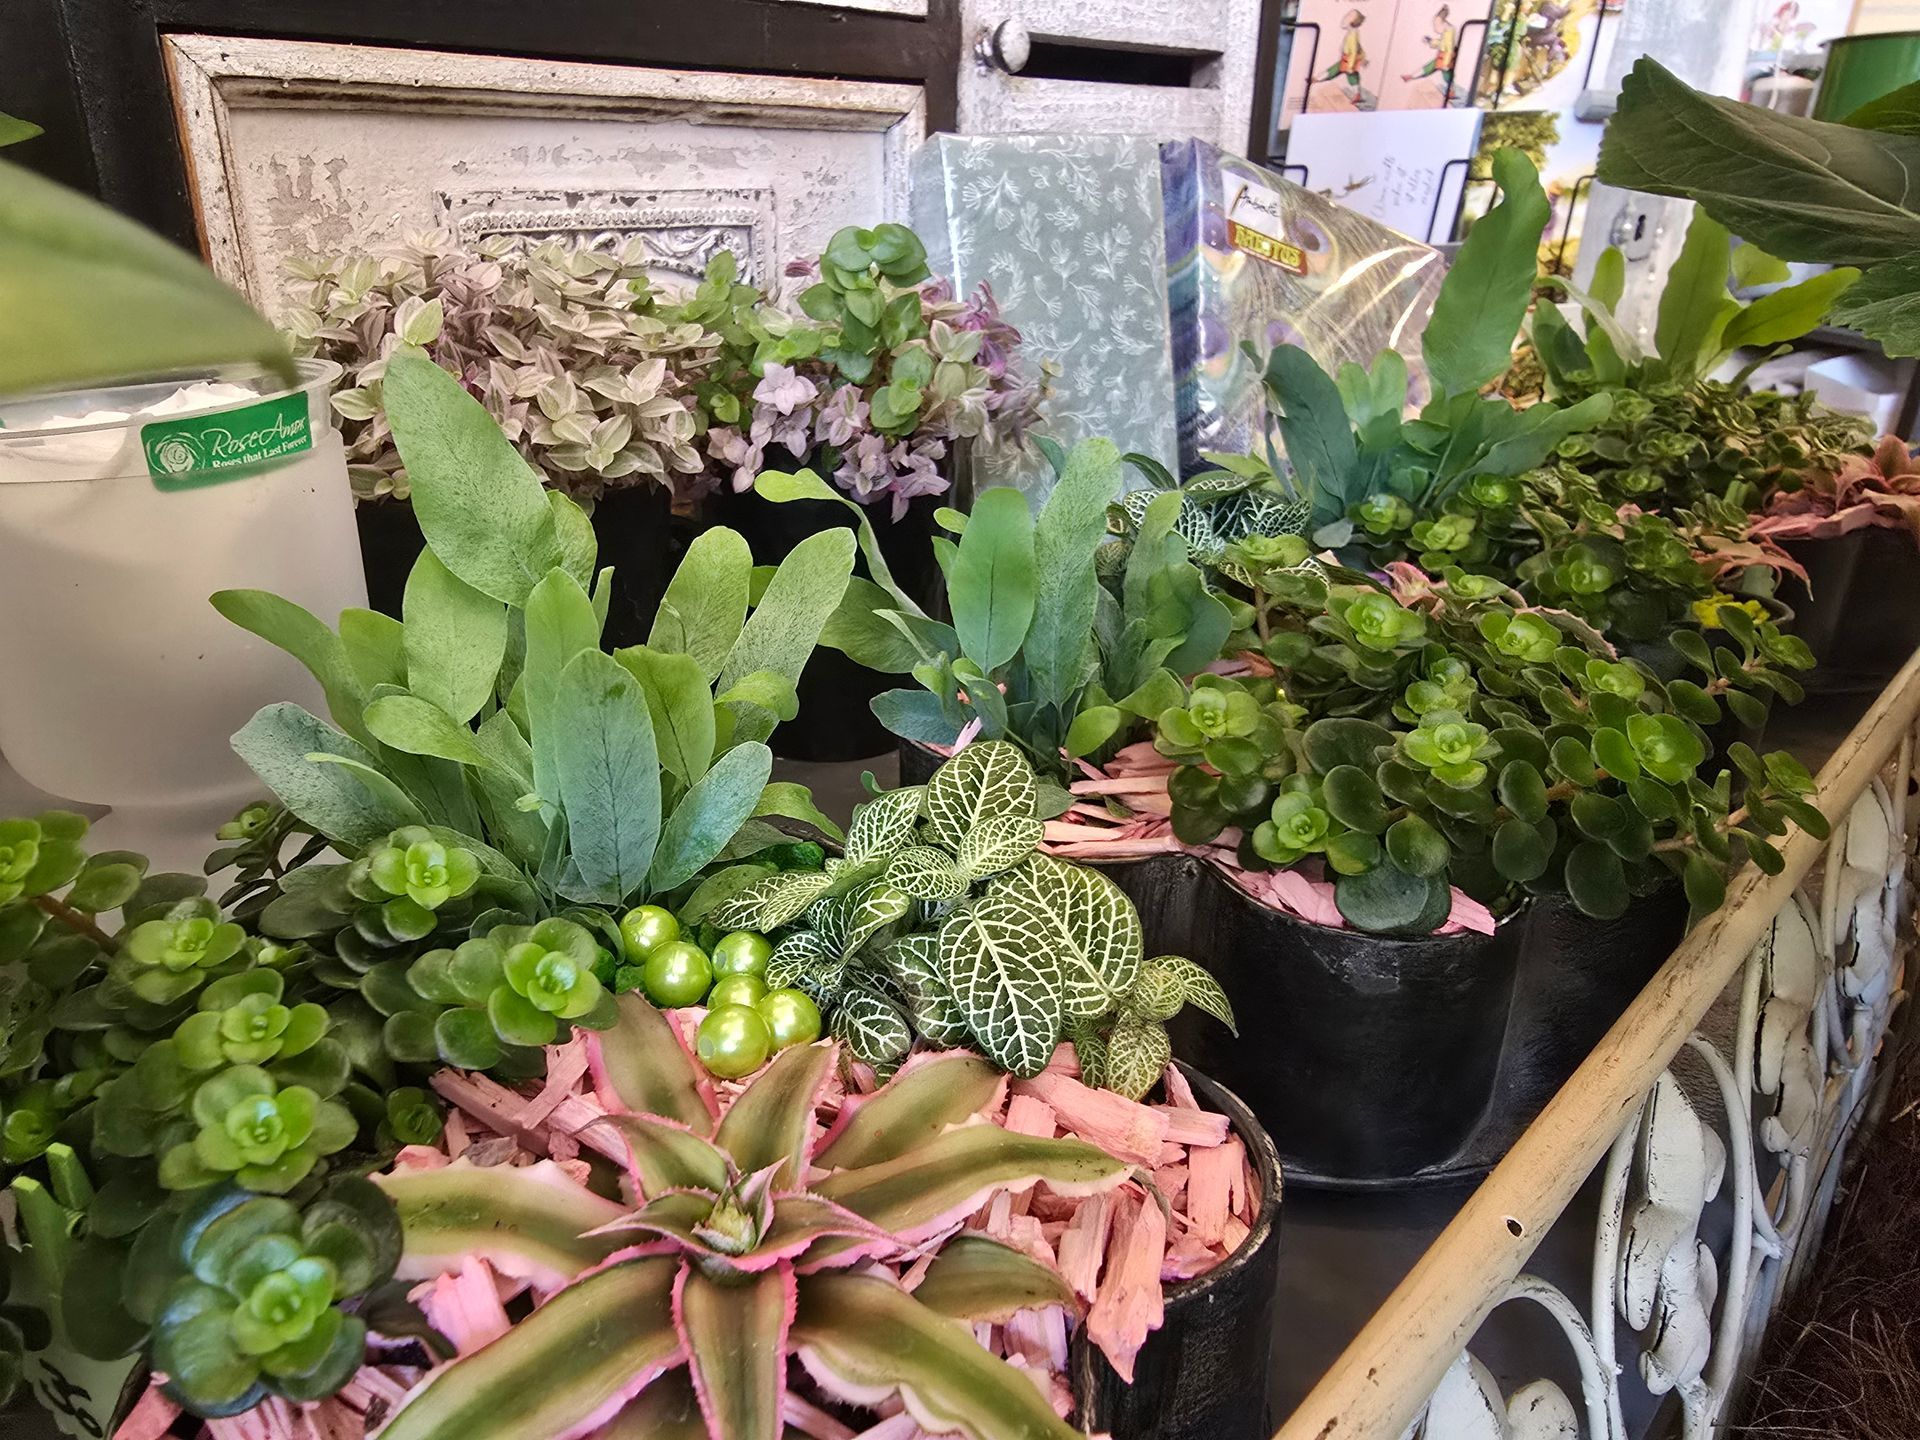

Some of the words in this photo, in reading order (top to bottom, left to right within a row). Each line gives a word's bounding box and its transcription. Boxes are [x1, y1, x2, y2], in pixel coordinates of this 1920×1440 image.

[212, 456, 242, 468] Roses
[243, 452, 262, 464] that
[264, 446, 282, 458] Last
